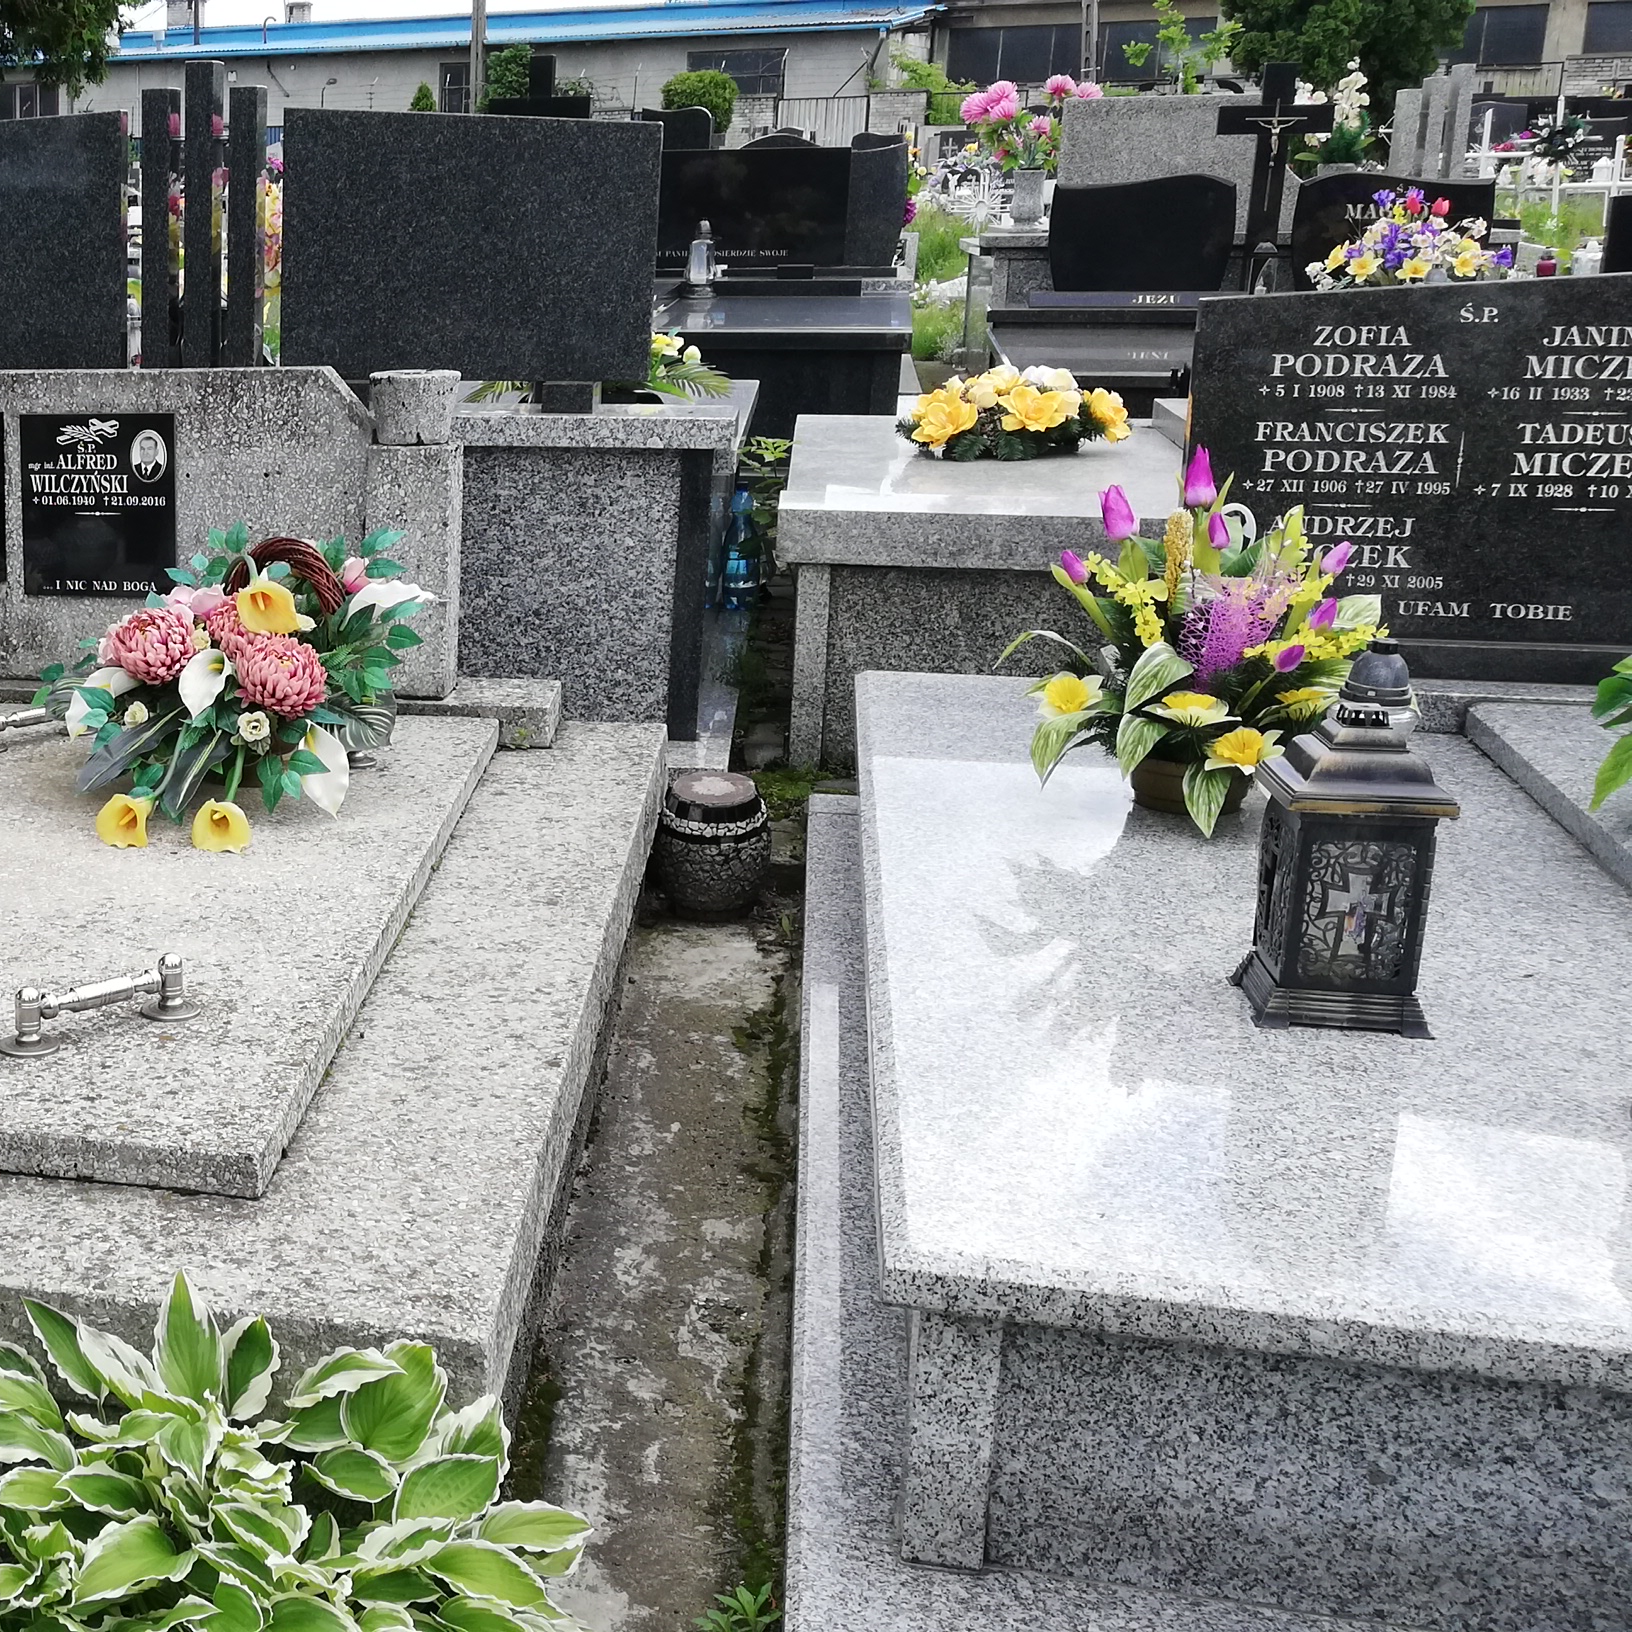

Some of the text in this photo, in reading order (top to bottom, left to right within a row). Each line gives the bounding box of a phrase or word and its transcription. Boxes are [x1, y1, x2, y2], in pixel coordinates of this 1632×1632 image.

[759, 249, 789, 257] SWOJE
[1131, 294, 1180, 305] JEZU
[1459, 302, 1499, 323] Ś.P.
[1313, 325, 1412, 347] ZOFIA
[1270, 353, 1450, 379] PODRAZA
[1274, 384, 1285, 398] 5
[1293, 384, 1302, 398] I
[1308, 384, 1346, 398] 1908
[1392, 384, 1412, 399] XI
[1419, 384, 1458, 399] 1984
[1528, 386, 1544, 400] II
[1553, 386, 1590, 401] 1933
[1254, 421, 1451, 444] FRANCISZEK
[1517, 423, 1632, 446] TADEU
[56, 454, 118, 470] ALFRED
[1261, 449, 1439, 475] PODRAZA
[30, 470, 129, 494] WILCZYŃSKI
[1280, 479, 1305, 493] XII
[1312, 480, 1347, 493] 1906
[1390, 481, 1410, 494] IV
[1416, 481, 1451, 495] 1995
[1491, 483, 1502, 497] 7
[1508, 483, 1529, 497] IX
[1535, 483, 1574, 498] 1928
[41, 495, 166, 507] 01.06.1940 21.09.2016
[66, 580, 87, 590] NIC
[92, 580, 117, 591] NAD
[123, 581, 157, 592] BOGA
[1381, 575, 1400, 588] XI
[1407, 575, 1444, 590] 2005
[1398, 600, 1573, 621] UFAM TOBIE
